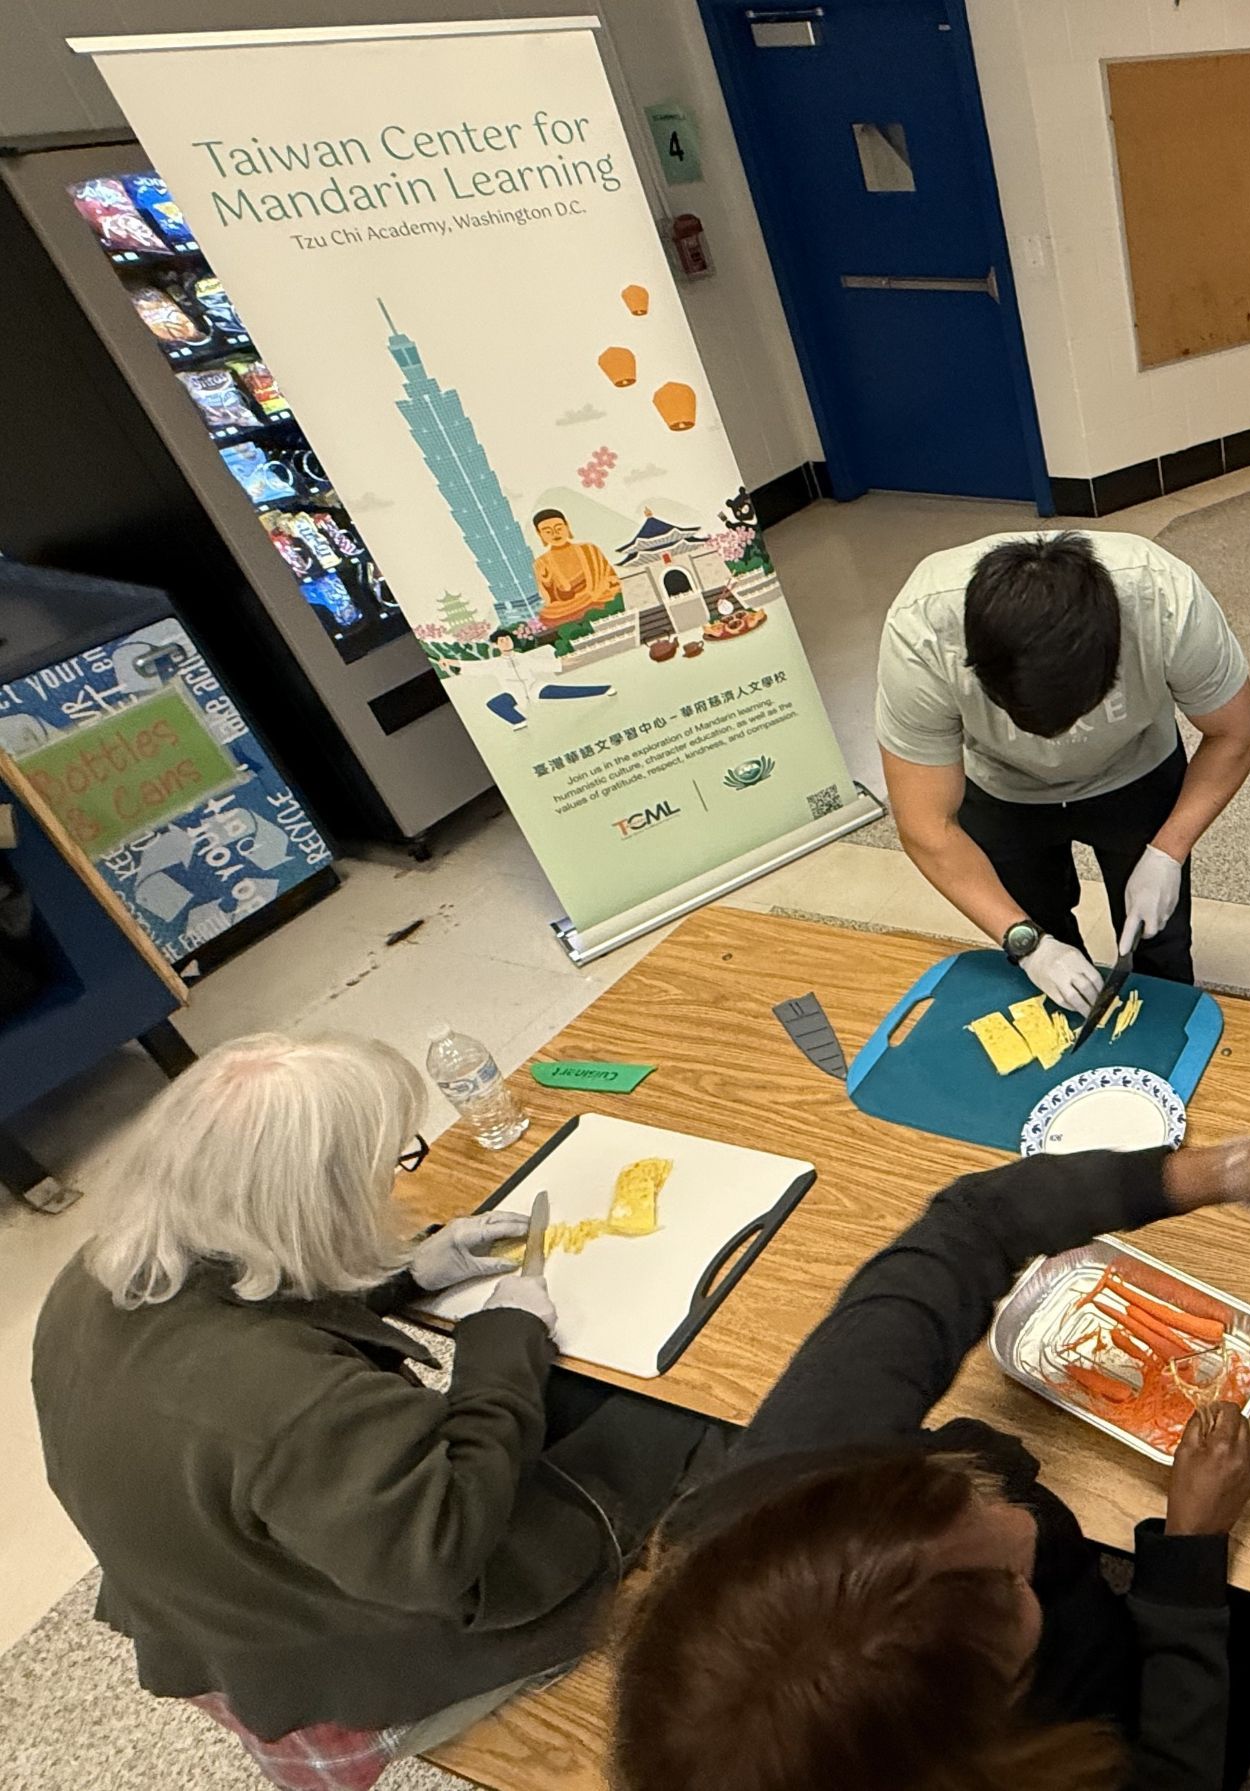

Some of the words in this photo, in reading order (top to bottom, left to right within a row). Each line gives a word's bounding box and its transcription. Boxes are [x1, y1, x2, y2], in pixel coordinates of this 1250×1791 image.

[192, 136, 371, 179] Taiwan
[381, 120, 522, 162] Center
[533, 110, 591, 147] for
[669, 130, 685, 162] 4
[210, 172, 438, 228] Mandarin
[443, 153, 623, 203] Learning
[290, 234, 327, 250] Tzu
[330, 227, 363, 246] Chi
[368, 220, 453, 241] Academy,
[453, 206, 552, 230] Washington
[554, 199, 587, 217] D.C.
[25, 657, 85, 701] your
[27, 719, 180, 804] Bottles
[553, 775, 608, 803] humanistic
[645, 743, 688, 765] character
[736, 720, 748, 729] as
[748, 710, 766, 723] well
[767, 708, 778, 717] as
[778, 701, 793, 712] the
[555, 796, 589, 815] values
[589, 789, 600, 801] of
[601, 773, 647, 798] gratitude,
[728, 730, 746, 743] and
[746, 710, 799, 735] compassion.
[567, 771, 589, 785] Join
[589, 766, 603, 776] us
[603, 760, 613, 770] in
[614, 754, 631, 765] the
[632, 733, 684, 759] exploration
[684, 727, 694, 738] of
[694, 712, 737, 733] Mandarin
[112, 758, 202, 820] Cans
[611, 800, 682, 836] TCML
[267, 785, 332, 865] RECYCLE
[552, 1066, 619, 1082] Cuisinart
